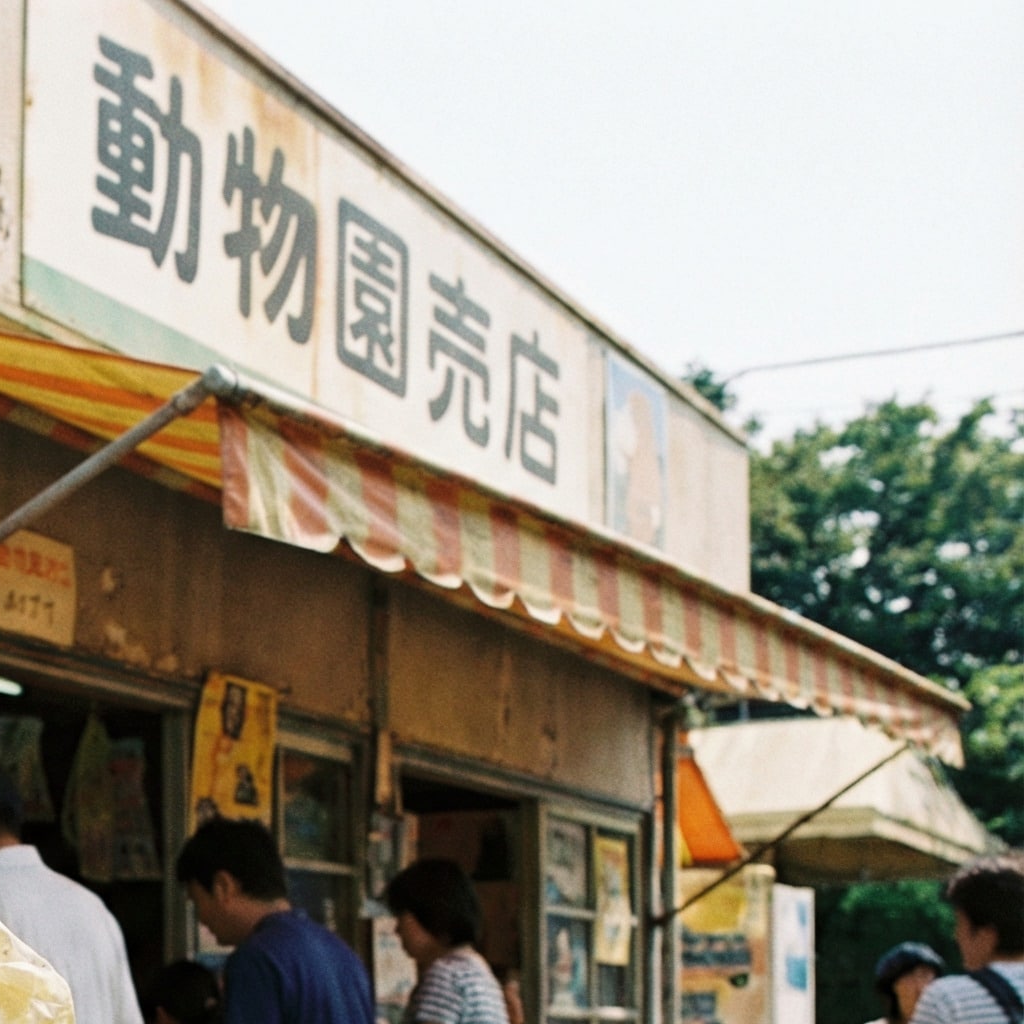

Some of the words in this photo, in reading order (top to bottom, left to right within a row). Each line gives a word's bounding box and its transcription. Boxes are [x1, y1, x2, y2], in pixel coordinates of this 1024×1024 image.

[91, 35, 561, 486] 動物園売店
